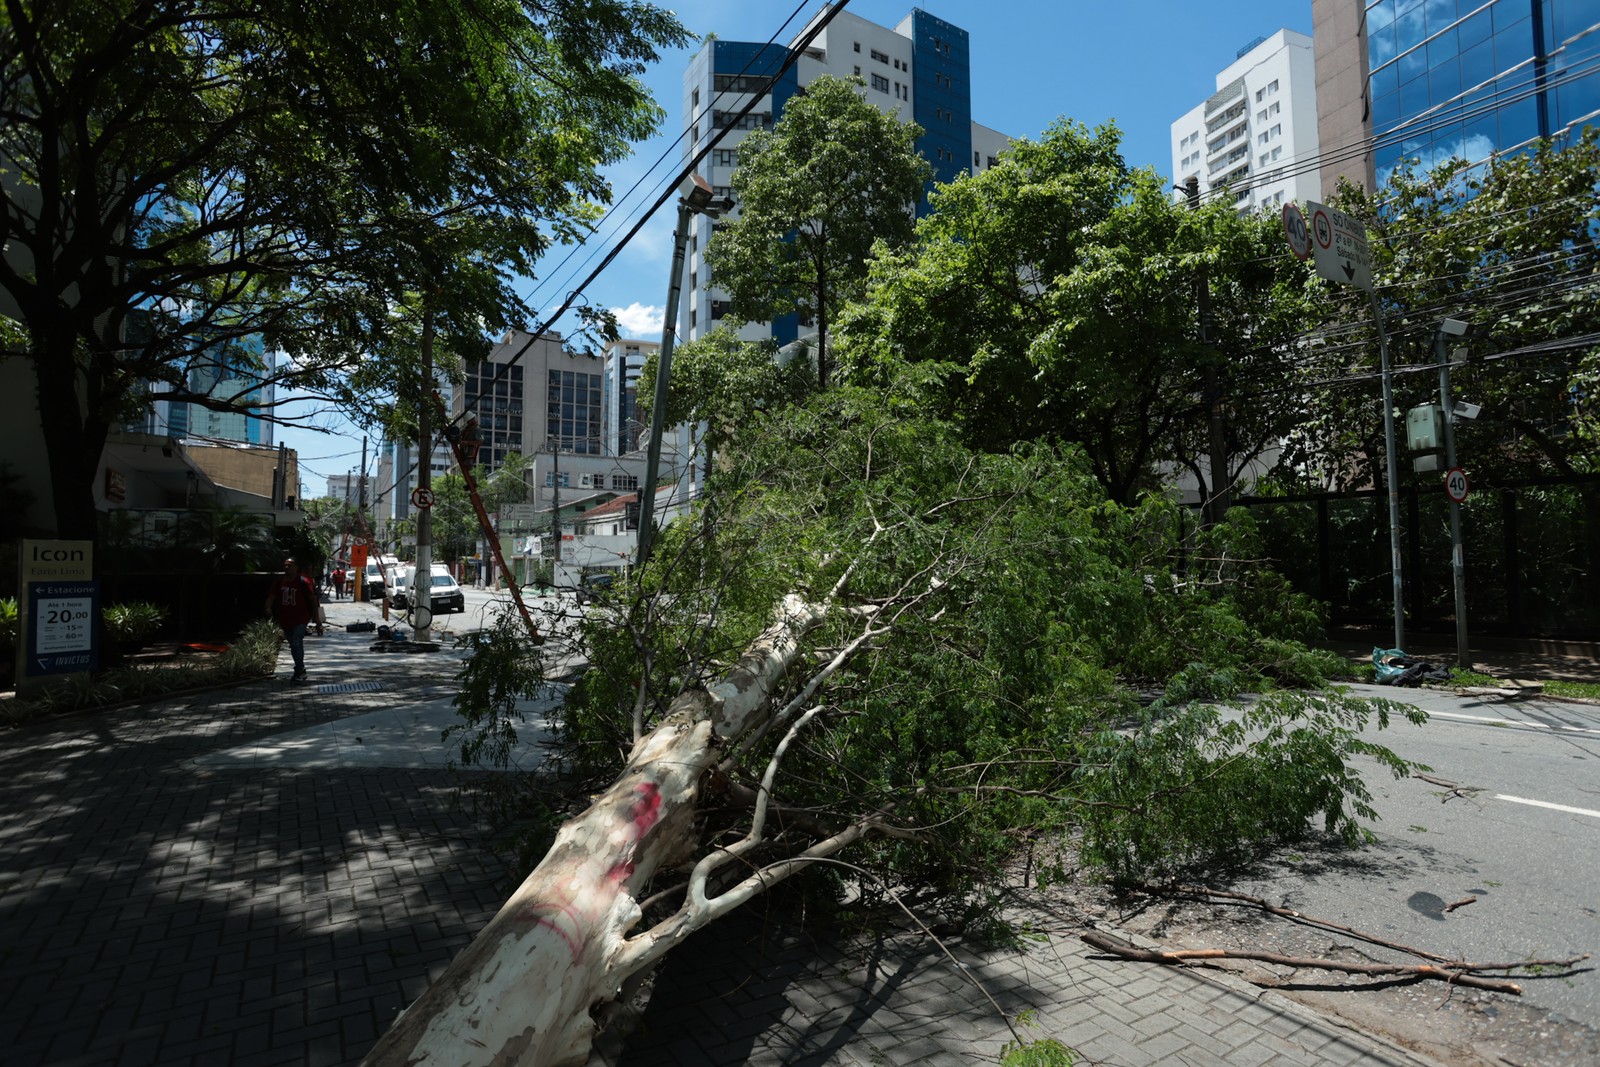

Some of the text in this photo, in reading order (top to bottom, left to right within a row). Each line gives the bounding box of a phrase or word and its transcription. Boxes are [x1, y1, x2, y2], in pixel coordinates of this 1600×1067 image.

[1287, 216, 1306, 241] 40
[1449, 477, 1465, 491] 40
[33, 546, 83, 562] Icon
[31, 567, 85, 576] Faria Lima
[47, 585, 96, 595] Estacione
[47, 609, 88, 624] 20,00
[55, 654, 91, 666] INVICTUS
